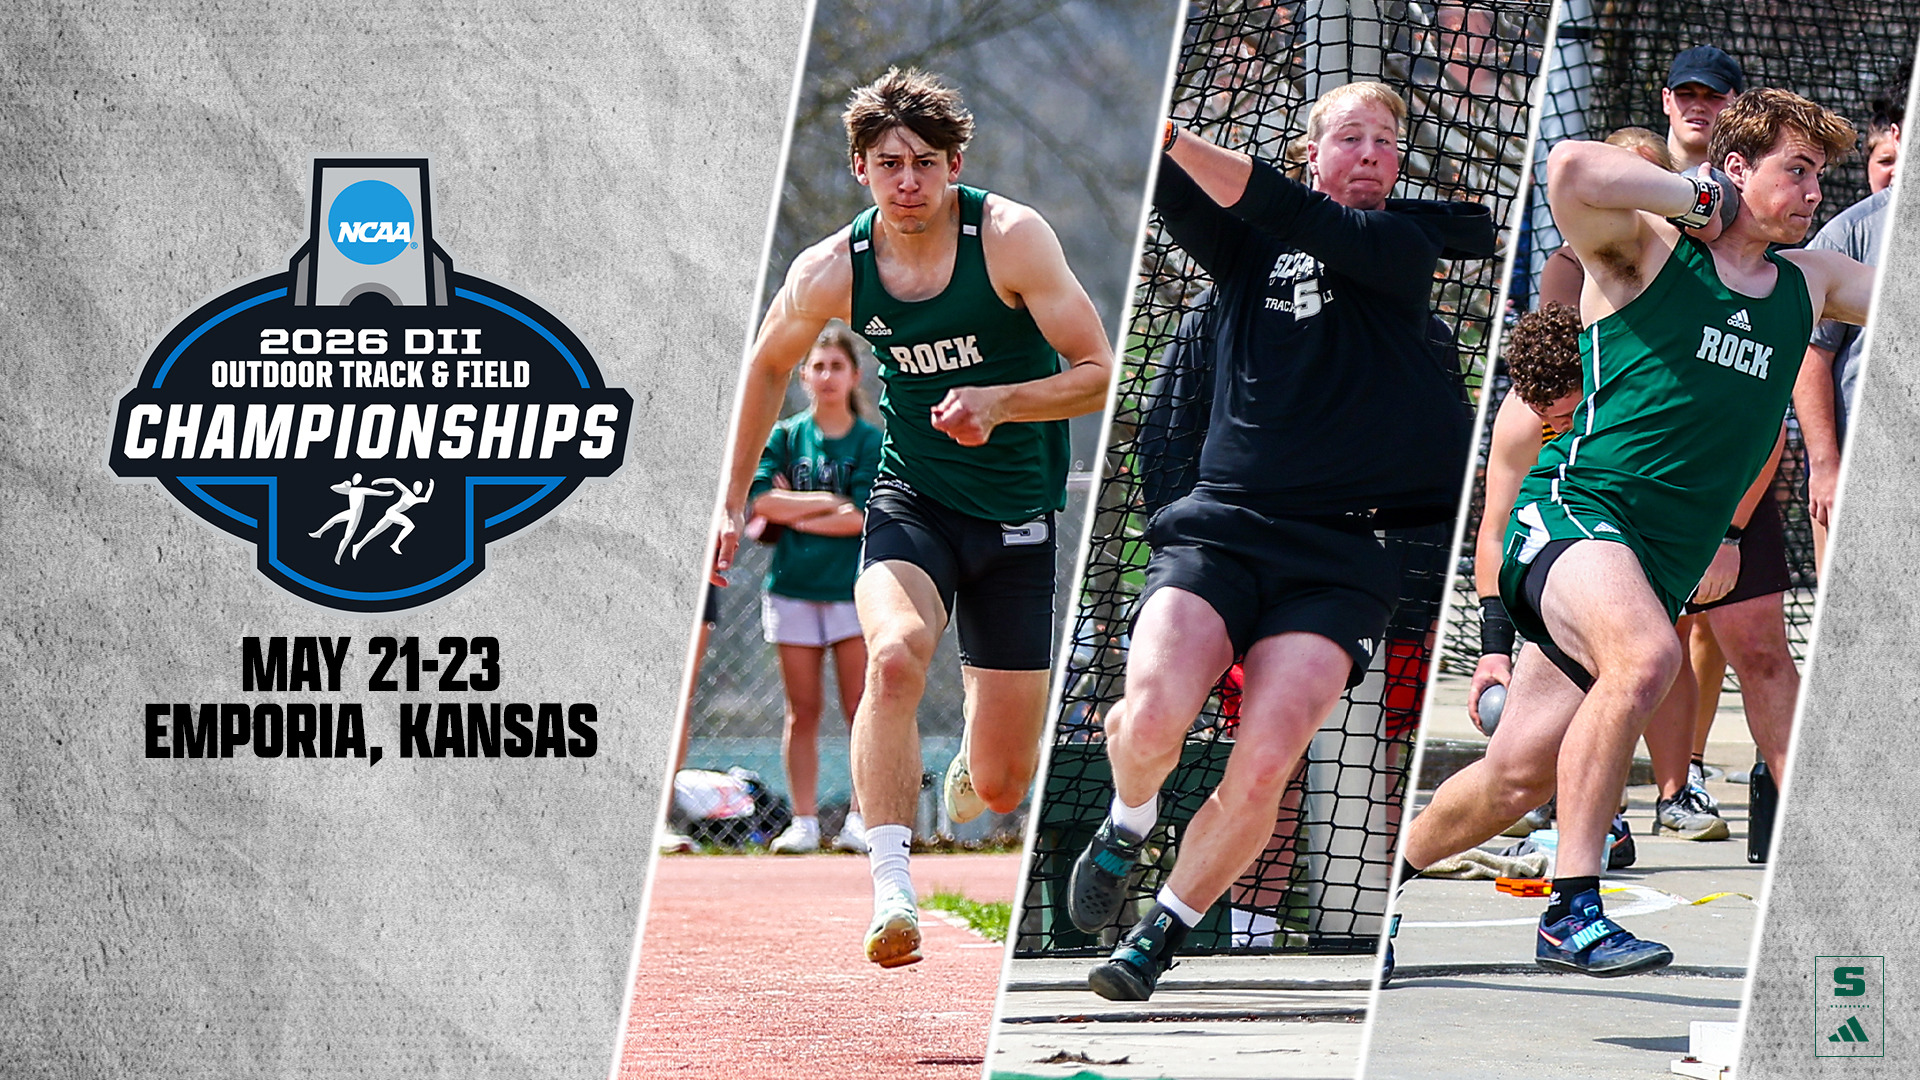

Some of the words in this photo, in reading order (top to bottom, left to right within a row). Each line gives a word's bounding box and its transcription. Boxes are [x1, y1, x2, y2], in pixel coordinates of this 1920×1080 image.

[864, 328, 893, 336] adidas
[1727, 318, 1752, 332] adidas
[889, 334, 984, 374] ROCK
[1695, 325, 1774, 380] ROCK
[1571, 919, 1610, 950] NIKE
